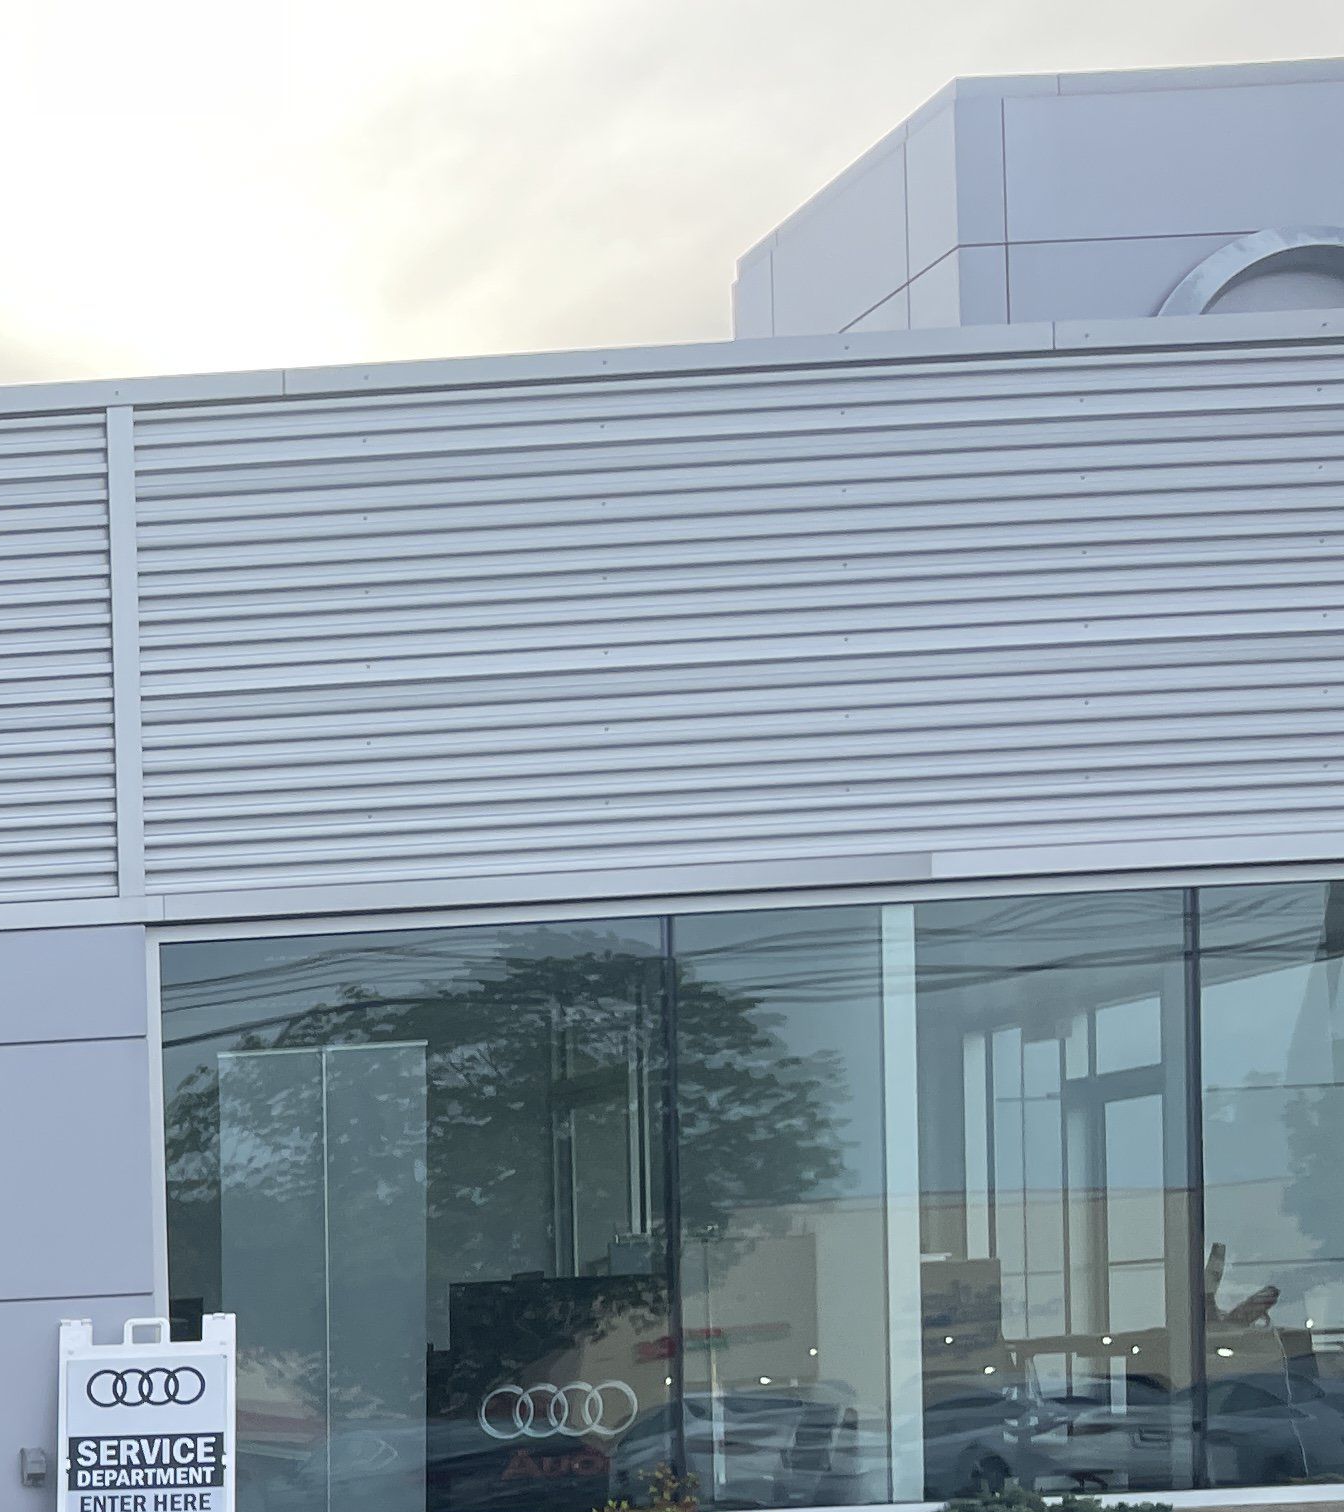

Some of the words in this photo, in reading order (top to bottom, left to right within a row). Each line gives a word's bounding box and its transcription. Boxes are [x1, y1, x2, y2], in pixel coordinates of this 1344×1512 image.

[77, 1436, 216, 1467] SERVICE
[77, 1466, 215, 1487] DEPARTMENT
[80, 1495, 146, 1512] ENTER
[153, 1493, 212, 1512] HERE
